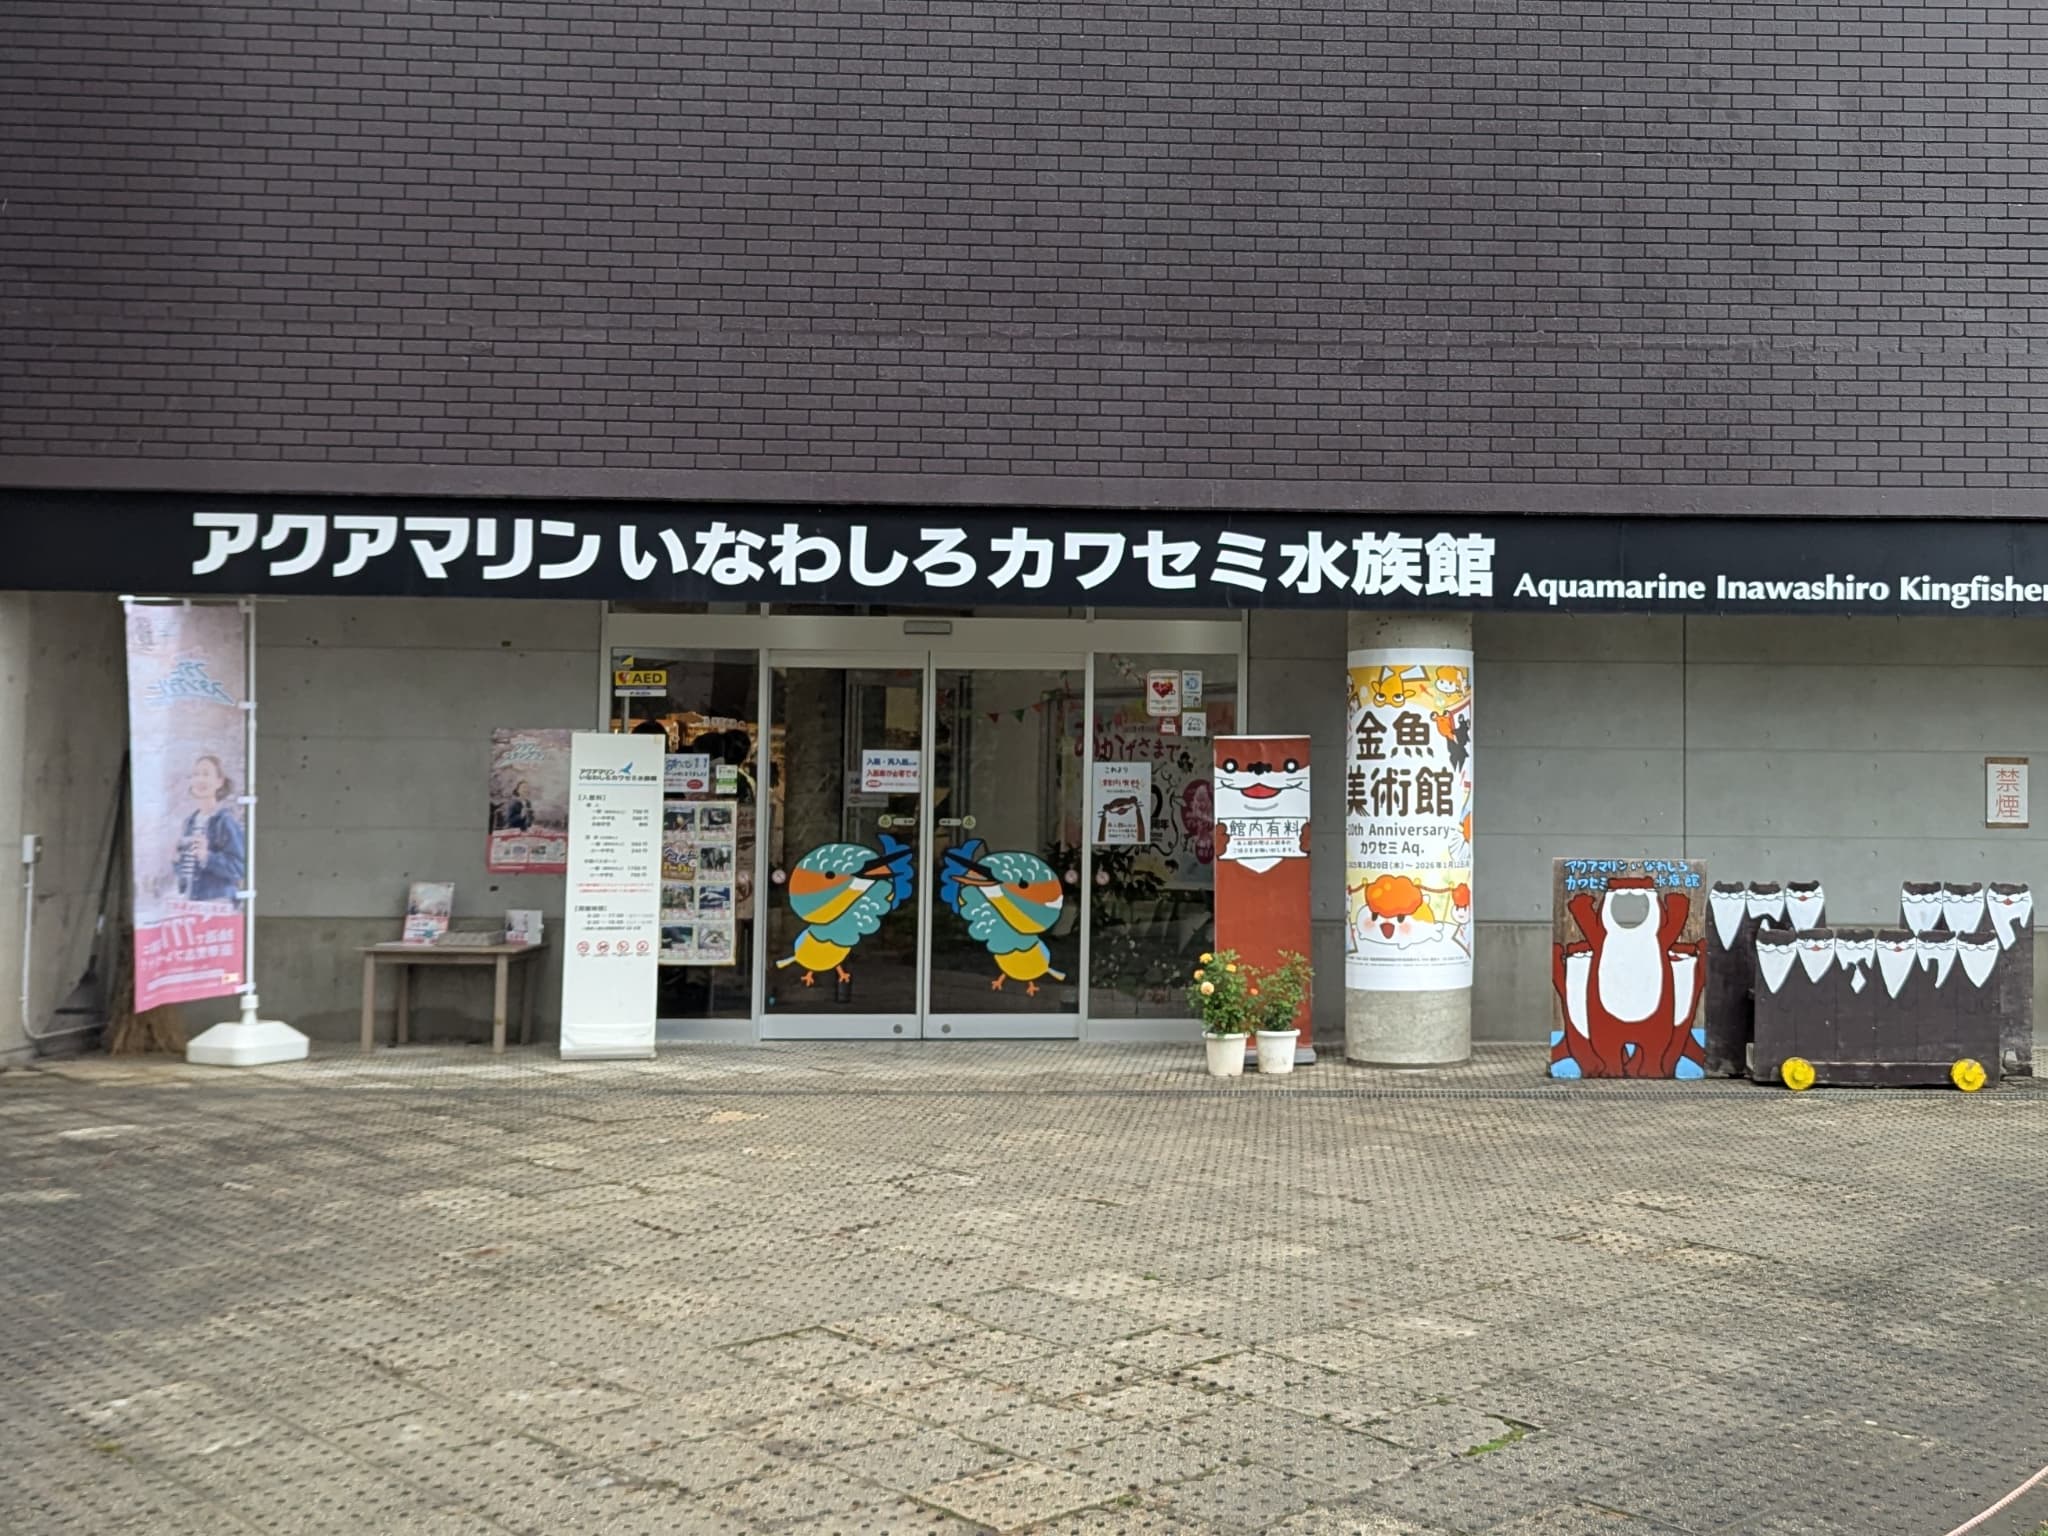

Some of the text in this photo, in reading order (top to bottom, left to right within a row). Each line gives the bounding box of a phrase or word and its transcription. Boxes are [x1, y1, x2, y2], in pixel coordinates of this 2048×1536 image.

[192, 512, 1496, 597] アクアマリン いなわしろカワセミ水族館
[1513, 572, 1706, 604] Aquamarine
[1716, 574, 1890, 600] Inawashiro
[632, 672, 663, 684] AED
[1355, 710, 1435, 761] 金魚
[1347, 764, 1455, 818] 美術館
[1995, 767, 2020, 818] 禁煙
[1229, 819, 1299, 837] 館内有料
[1359, 841, 1425, 857] カワセミ Aq.
[1565, 875, 1609, 892] カワセミ
